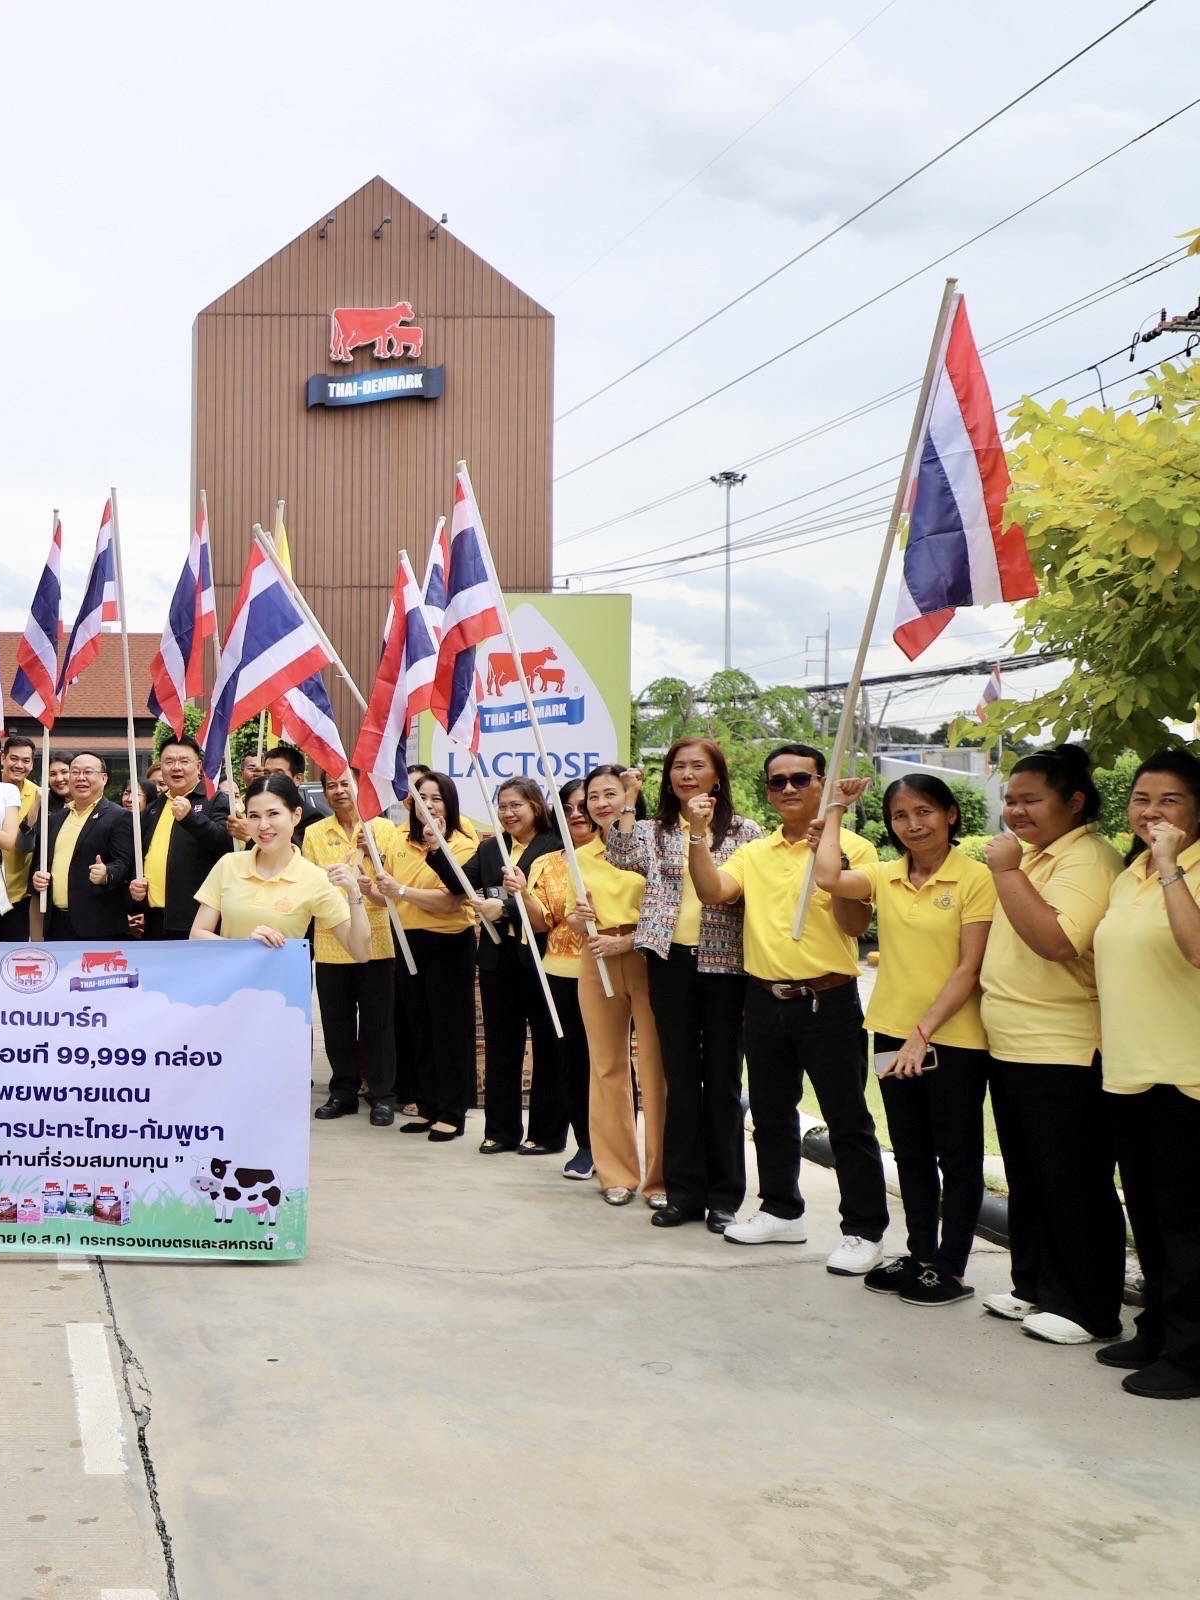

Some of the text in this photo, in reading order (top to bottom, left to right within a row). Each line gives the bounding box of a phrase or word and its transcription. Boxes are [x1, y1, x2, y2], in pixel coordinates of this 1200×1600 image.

[327, 373, 424, 398] THAI-DENMARK
[484, 703, 568, 727] THAI-DEMARK
[80, 976, 129, 989] THAI-DENMARK
[57, 1046, 147, 1069] 99,999
[154, 1045, 223, 1067] กล่อง
[21, 1233, 72, 1246] (อ.ส.ค)
[80, 1235, 275, 1252] กระทรวงเกษตรและสหกรณ์
